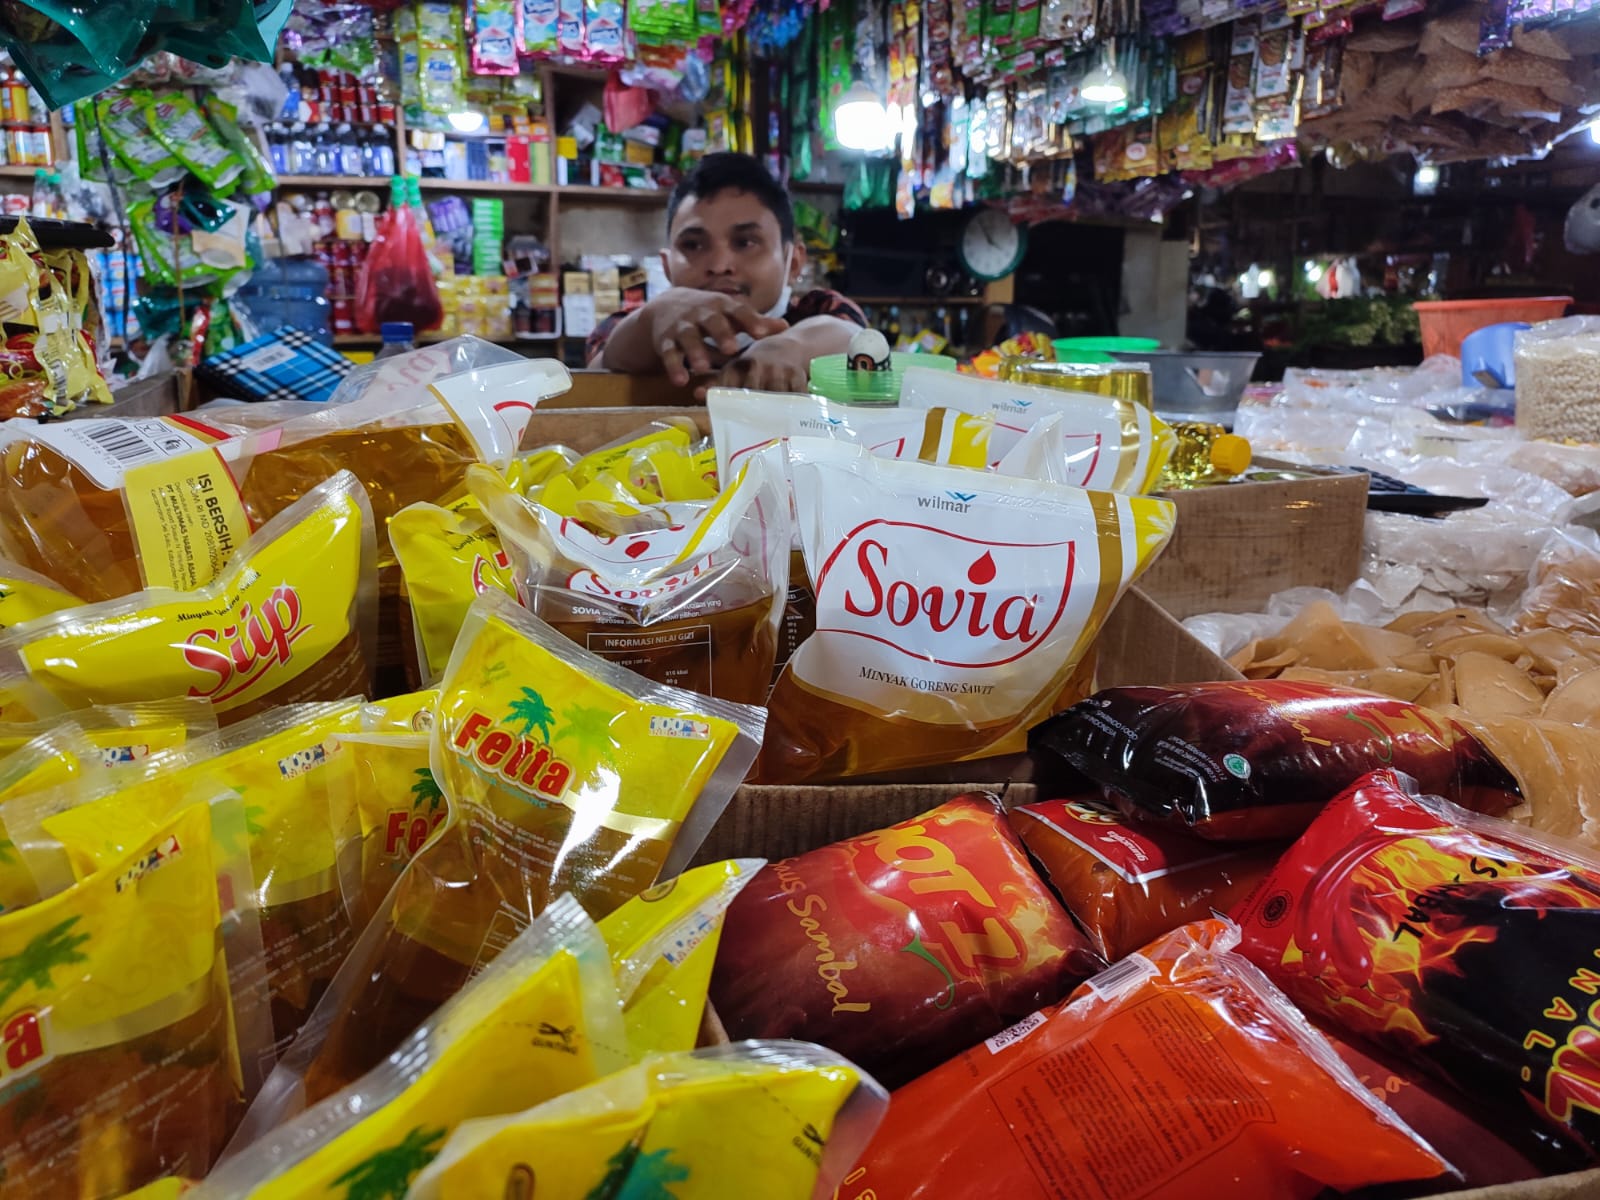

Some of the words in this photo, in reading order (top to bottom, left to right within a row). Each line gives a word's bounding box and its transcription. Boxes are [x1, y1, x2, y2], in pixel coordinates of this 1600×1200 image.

[992, 402, 1028, 415] wilmar
[198, 474, 214, 493] ISI
[917, 496, 971, 514] wilmar
[170, 495, 187, 534] MULTIMAS
[187, 562, 197, 586] ASAHA
[205, 497, 233, 555] BERSIH:
[571, 605, 601, 615] SOVIA
[845, 540, 1038, 642] Sovia
[184, 586, 301, 698] Siip
[605, 635, 654, 648] INFORMASI
[655, 633, 677, 644] NILAI
[679, 631, 695, 643] GIZI
[859, 667, 908, 687] MINYAK
[910, 677, 958, 693] GORENG
[960, 682, 995, 695] SAWIT
[454, 712, 570, 798] Fetta
[786, 894, 872, 1016] Sambal
